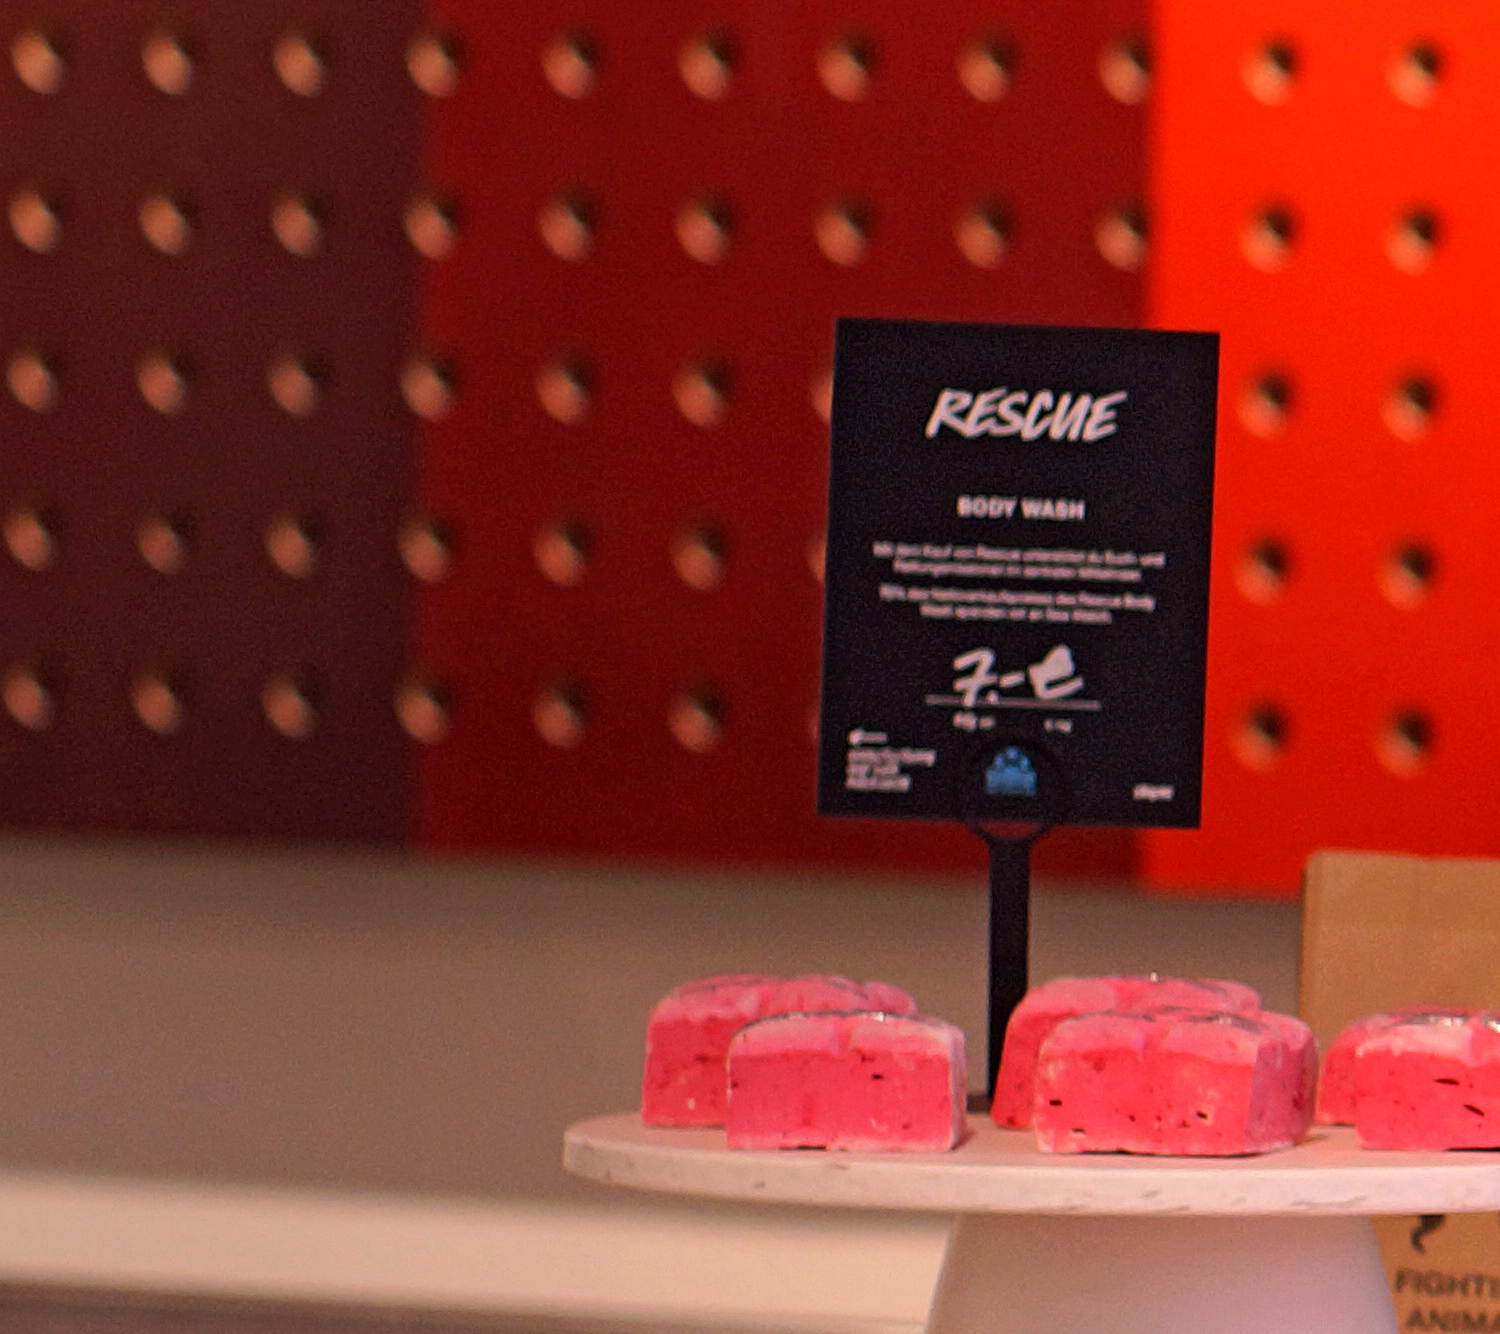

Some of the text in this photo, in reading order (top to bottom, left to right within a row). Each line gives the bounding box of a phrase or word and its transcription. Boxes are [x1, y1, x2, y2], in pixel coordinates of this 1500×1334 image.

[925, 387, 1128, 442] RESCUE
[957, 495, 1086, 522] BODY WASH
